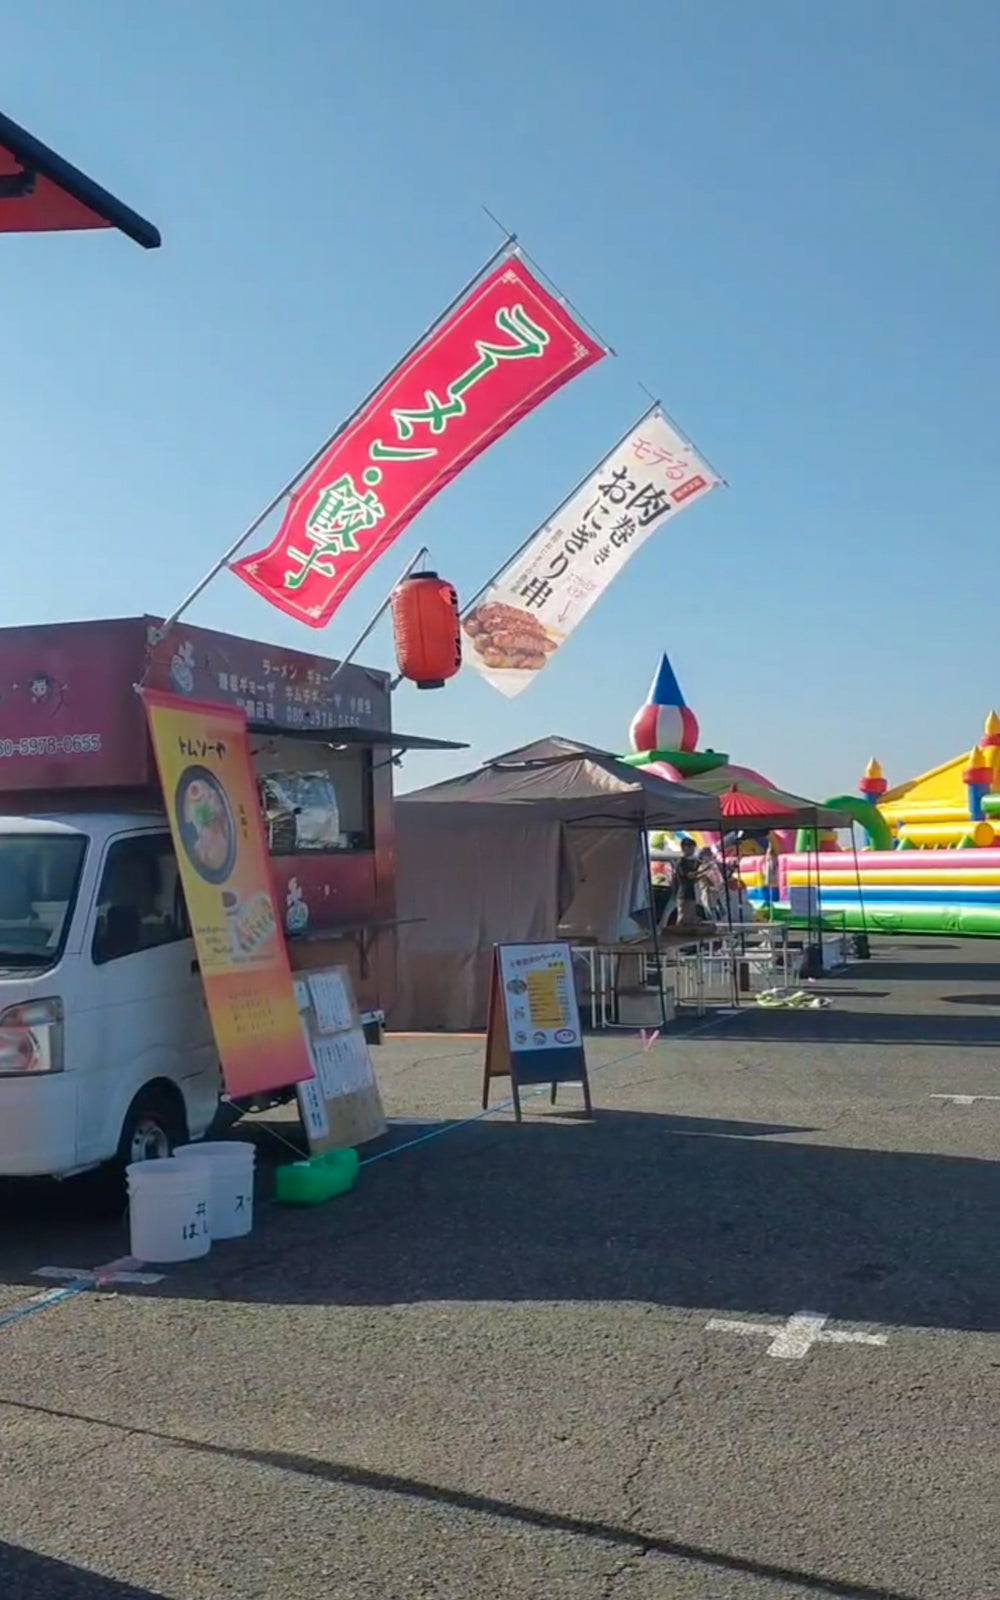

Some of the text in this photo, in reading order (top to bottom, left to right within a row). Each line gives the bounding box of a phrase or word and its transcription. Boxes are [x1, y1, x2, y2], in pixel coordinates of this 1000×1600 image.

[284, 304, 550, 589] ラーメン・餃子
[631, 437, 689, 481] モテる
[519, 465, 637, 609] おにぎり串
[593, 483, 672, 567] 肉巻き
[262, 659, 298, 680] ラーメン
